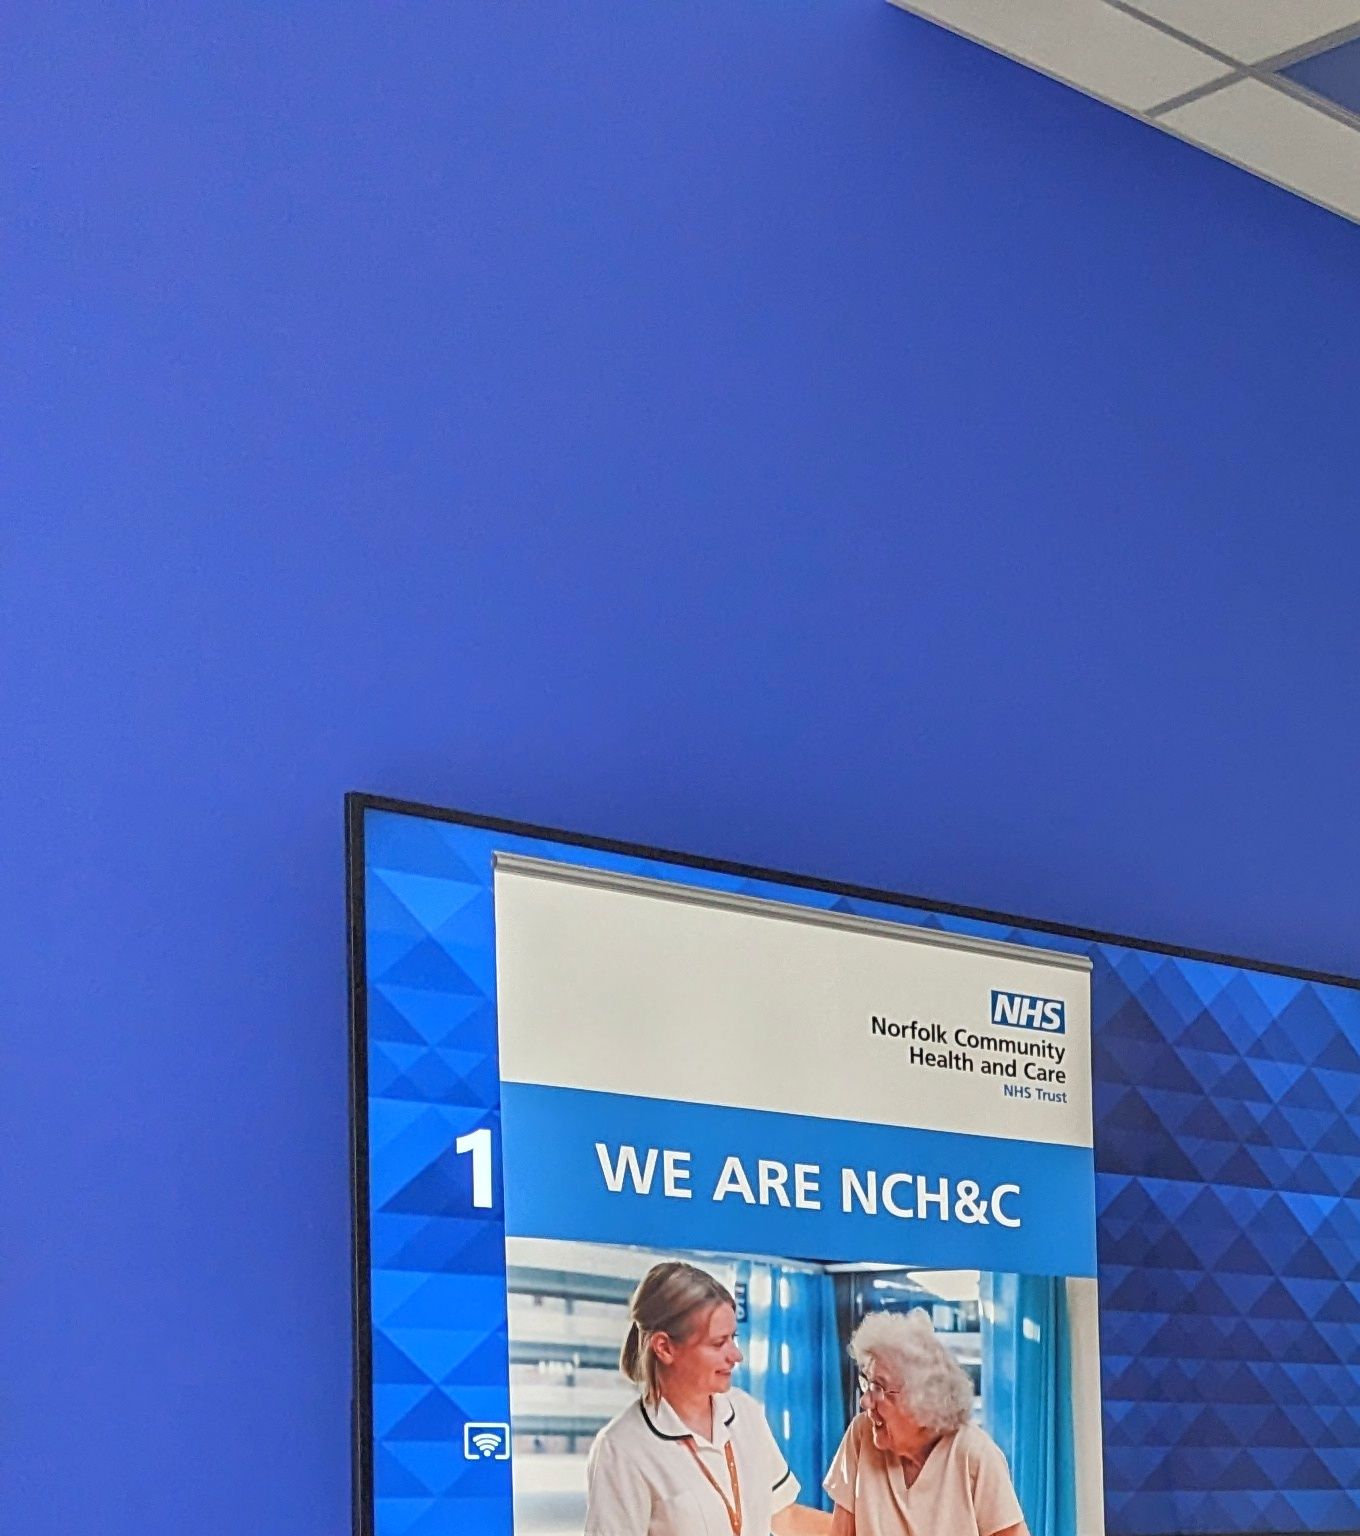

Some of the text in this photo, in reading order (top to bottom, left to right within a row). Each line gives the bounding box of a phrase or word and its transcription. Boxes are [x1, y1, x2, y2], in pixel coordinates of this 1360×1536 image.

[993, 992, 1064, 1032] NHS
[871, 1016, 1066, 1063] Norfolk Community
[909, 1046, 1067, 1084] Health and Care
[1003, 1083, 1068, 1104] NHS Trust
[595, 1142, 1022, 1228] WE ARE NCH&C
